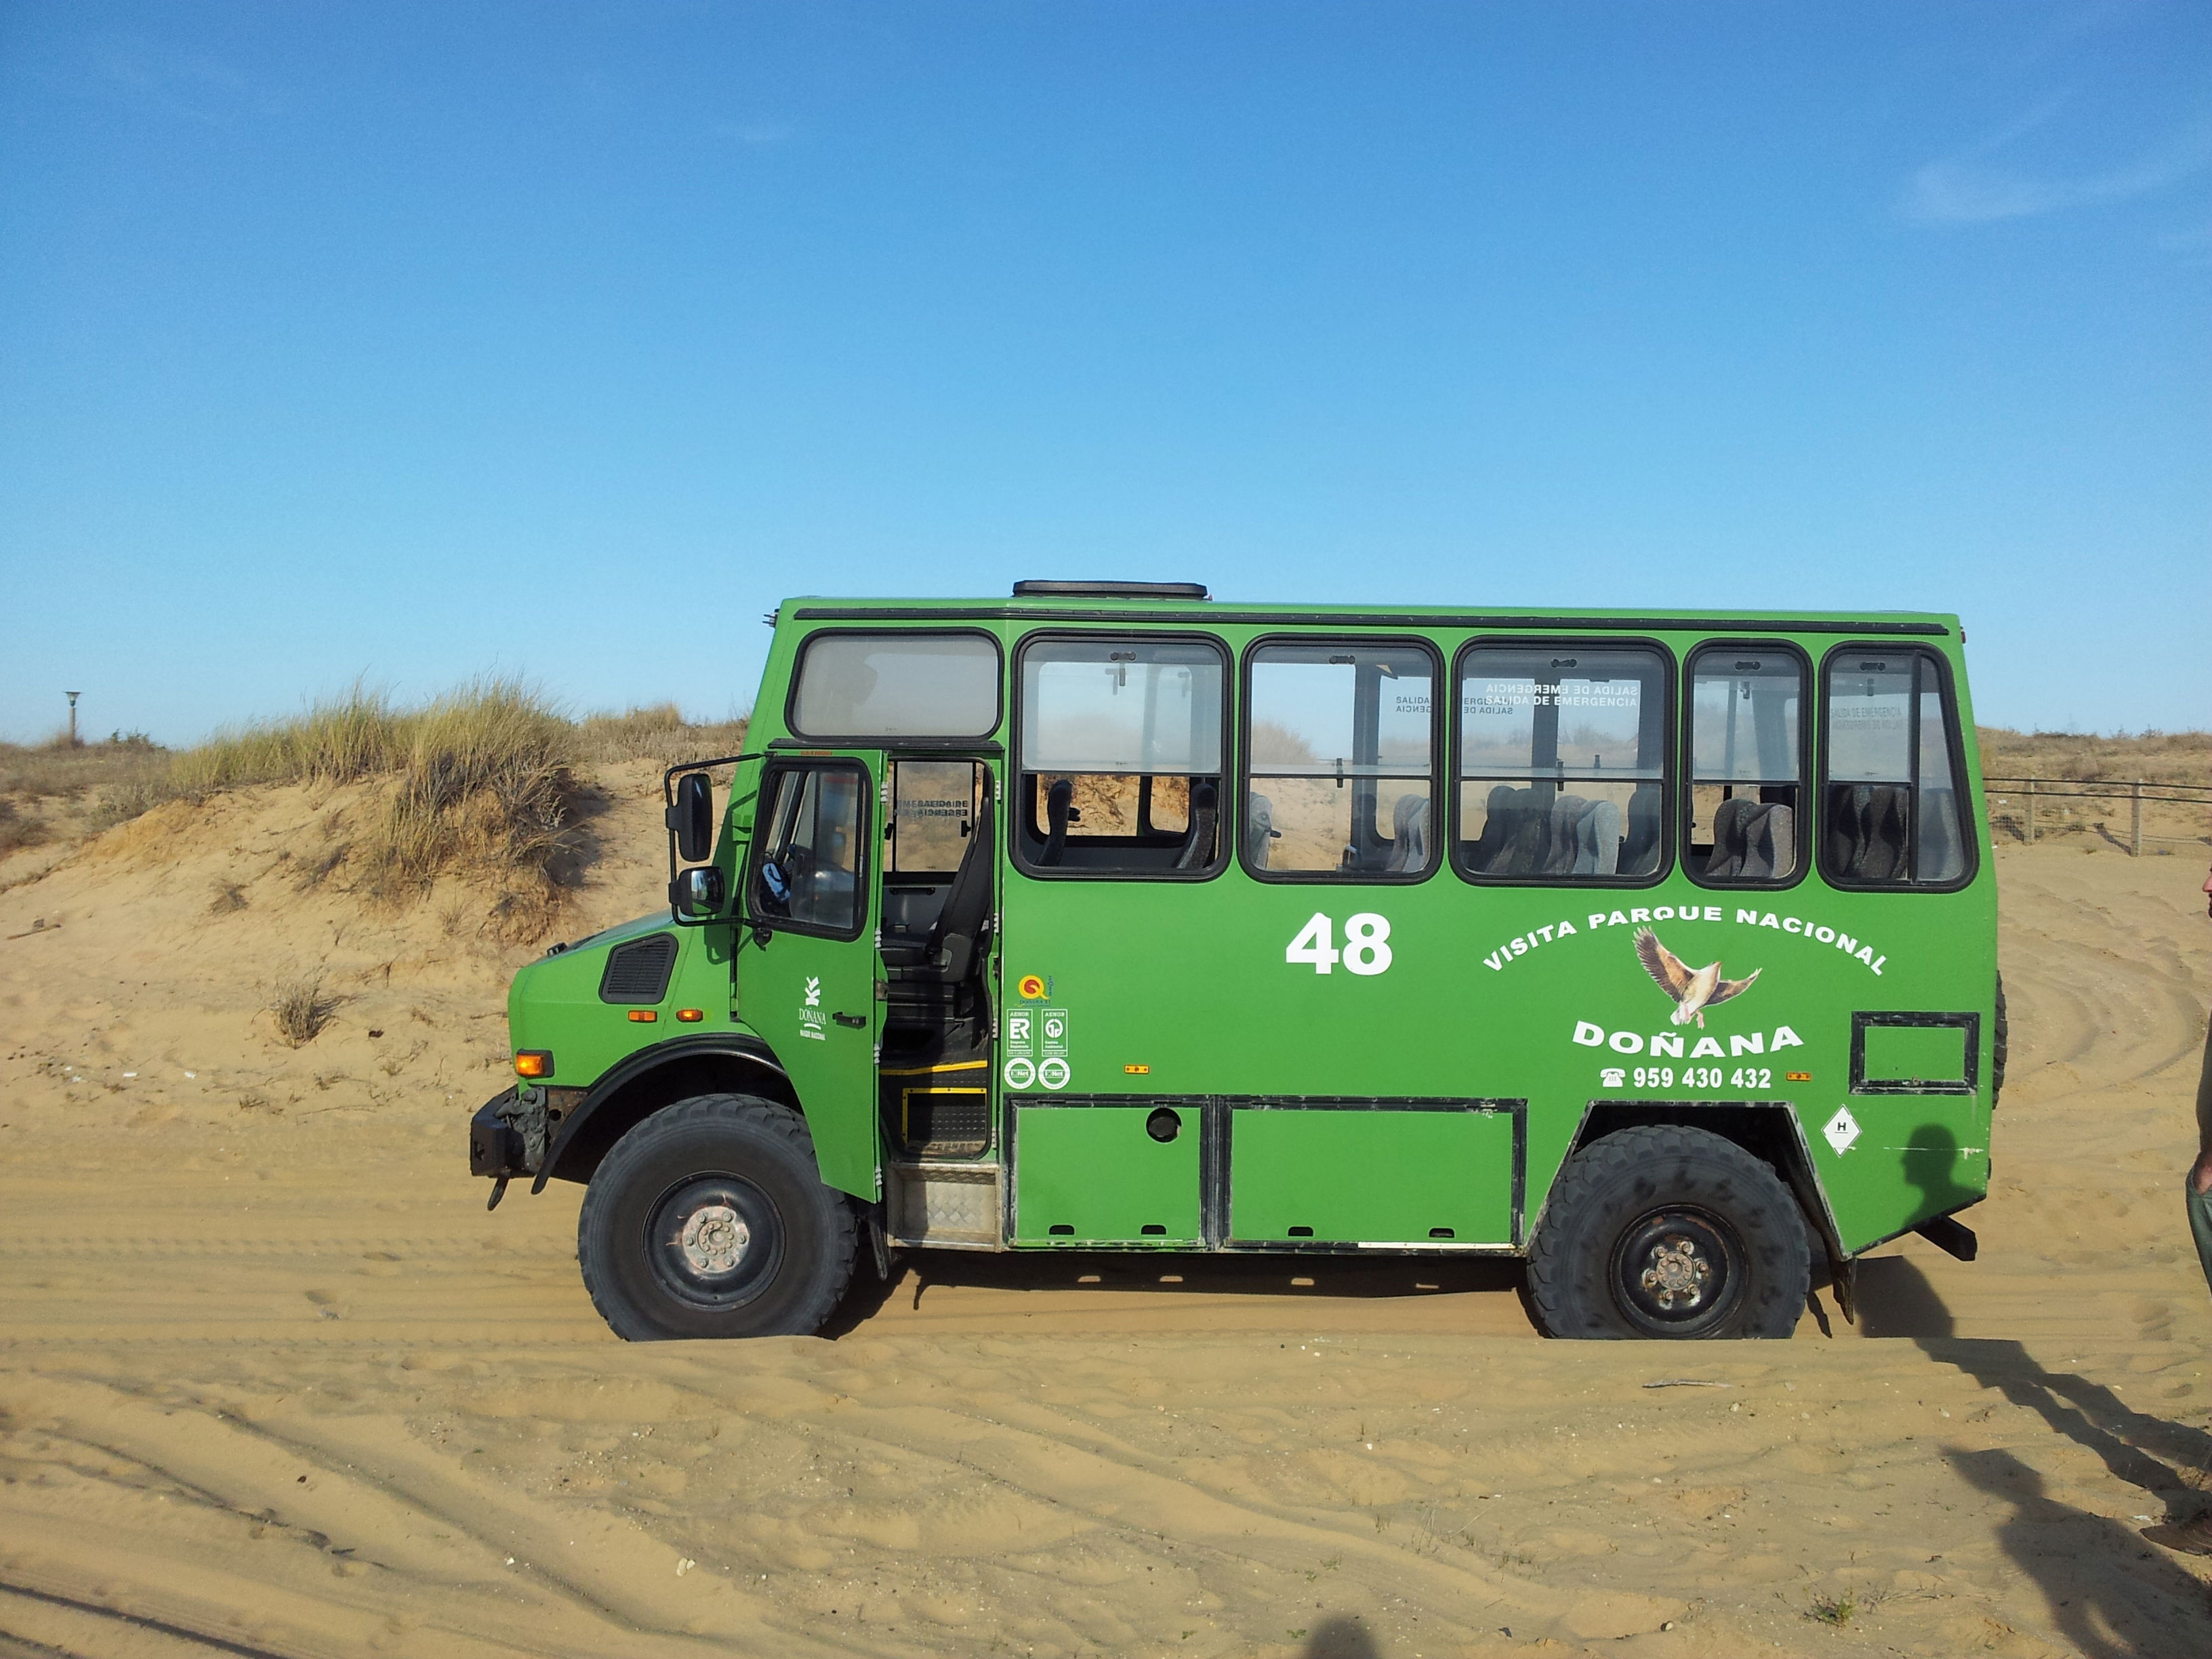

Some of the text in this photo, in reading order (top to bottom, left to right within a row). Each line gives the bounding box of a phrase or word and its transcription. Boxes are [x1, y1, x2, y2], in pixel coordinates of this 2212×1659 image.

[1486, 695, 1637, 707] SALIDA DE EMERGENCIA
[1286, 912, 1393, 975] 48
[1483, 905, 1887, 976] VISITA PARQUE NACIONAL
[799, 1007, 827, 1025] DOÑANA
[1572, 1020, 1804, 1059] DOÑANA
[1633, 1067, 1771, 1088] 959 430 432
[1837, 1122, 1847, 1131] H
